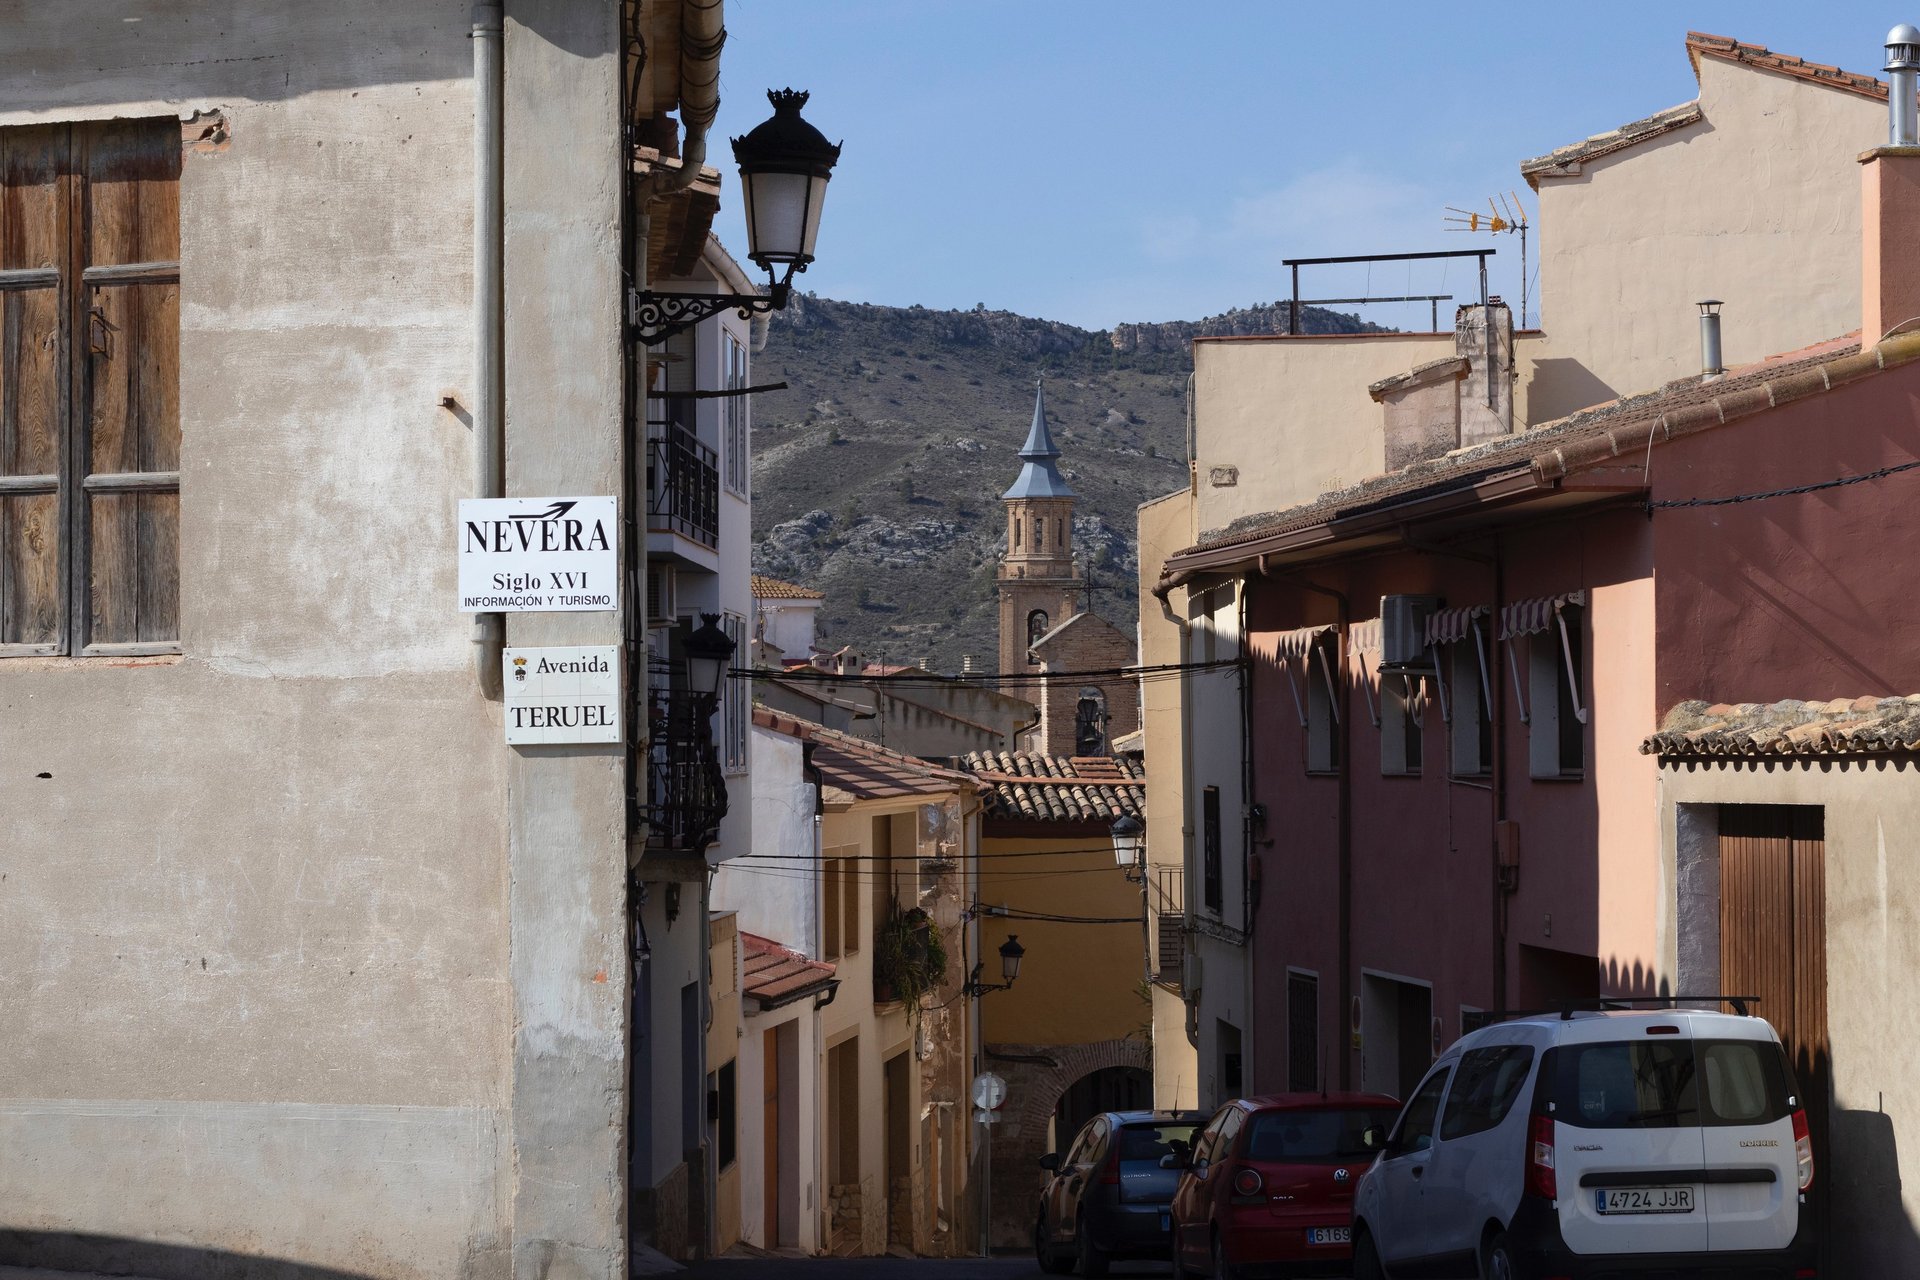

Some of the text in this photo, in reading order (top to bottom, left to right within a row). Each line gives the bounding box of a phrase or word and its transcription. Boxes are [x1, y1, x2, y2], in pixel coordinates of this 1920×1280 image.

[465, 519, 610, 553] NEVERA
[492, 572, 588, 593] Siglo XVI
[464, 594, 610, 607] INFORMACIÓN Y TURISMO
[536, 656, 609, 674] Avenida
[510, 705, 614, 728] TERUEL
[1610, 1191, 1689, 1208] 4724 JJR
[1315, 1228, 1350, 1242] 6169
